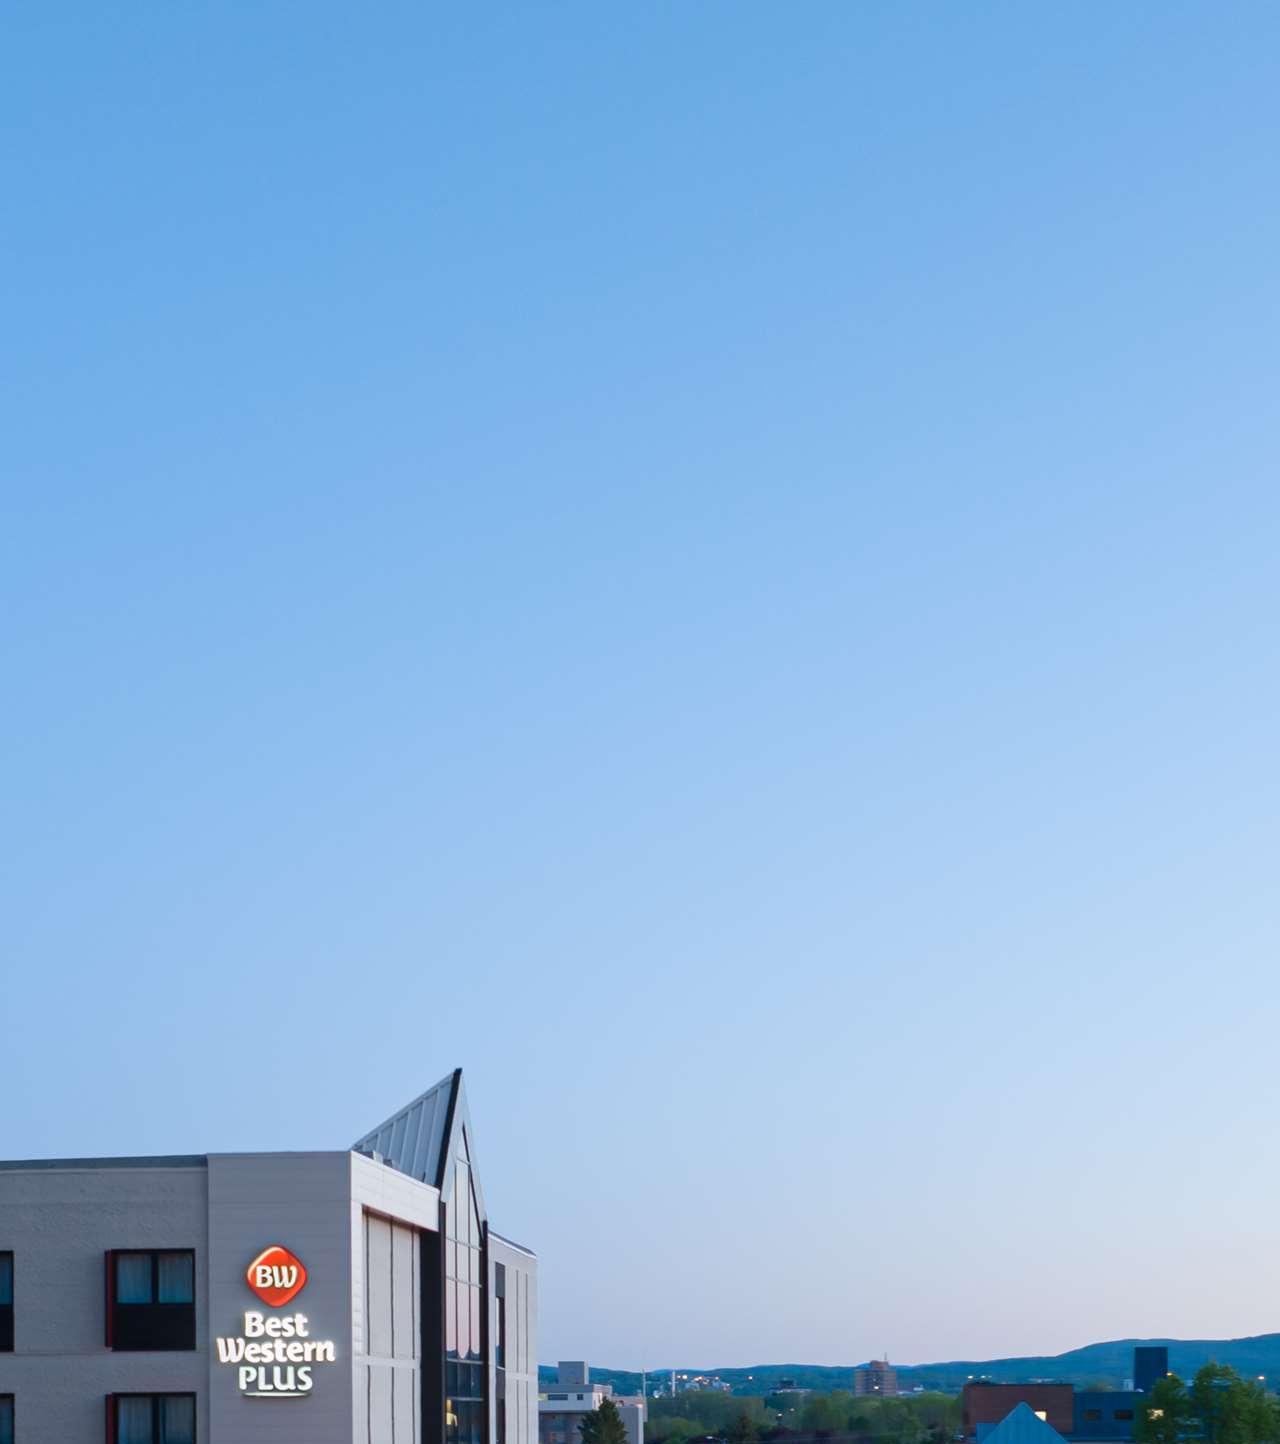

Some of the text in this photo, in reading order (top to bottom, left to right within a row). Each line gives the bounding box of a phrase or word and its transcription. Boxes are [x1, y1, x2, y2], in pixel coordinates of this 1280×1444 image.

[255, 1265, 299, 1289] BW
[244, 1311, 310, 1338] Best
[216, 1337, 337, 1364] Western
[238, 1366, 314, 1392] PLUS
